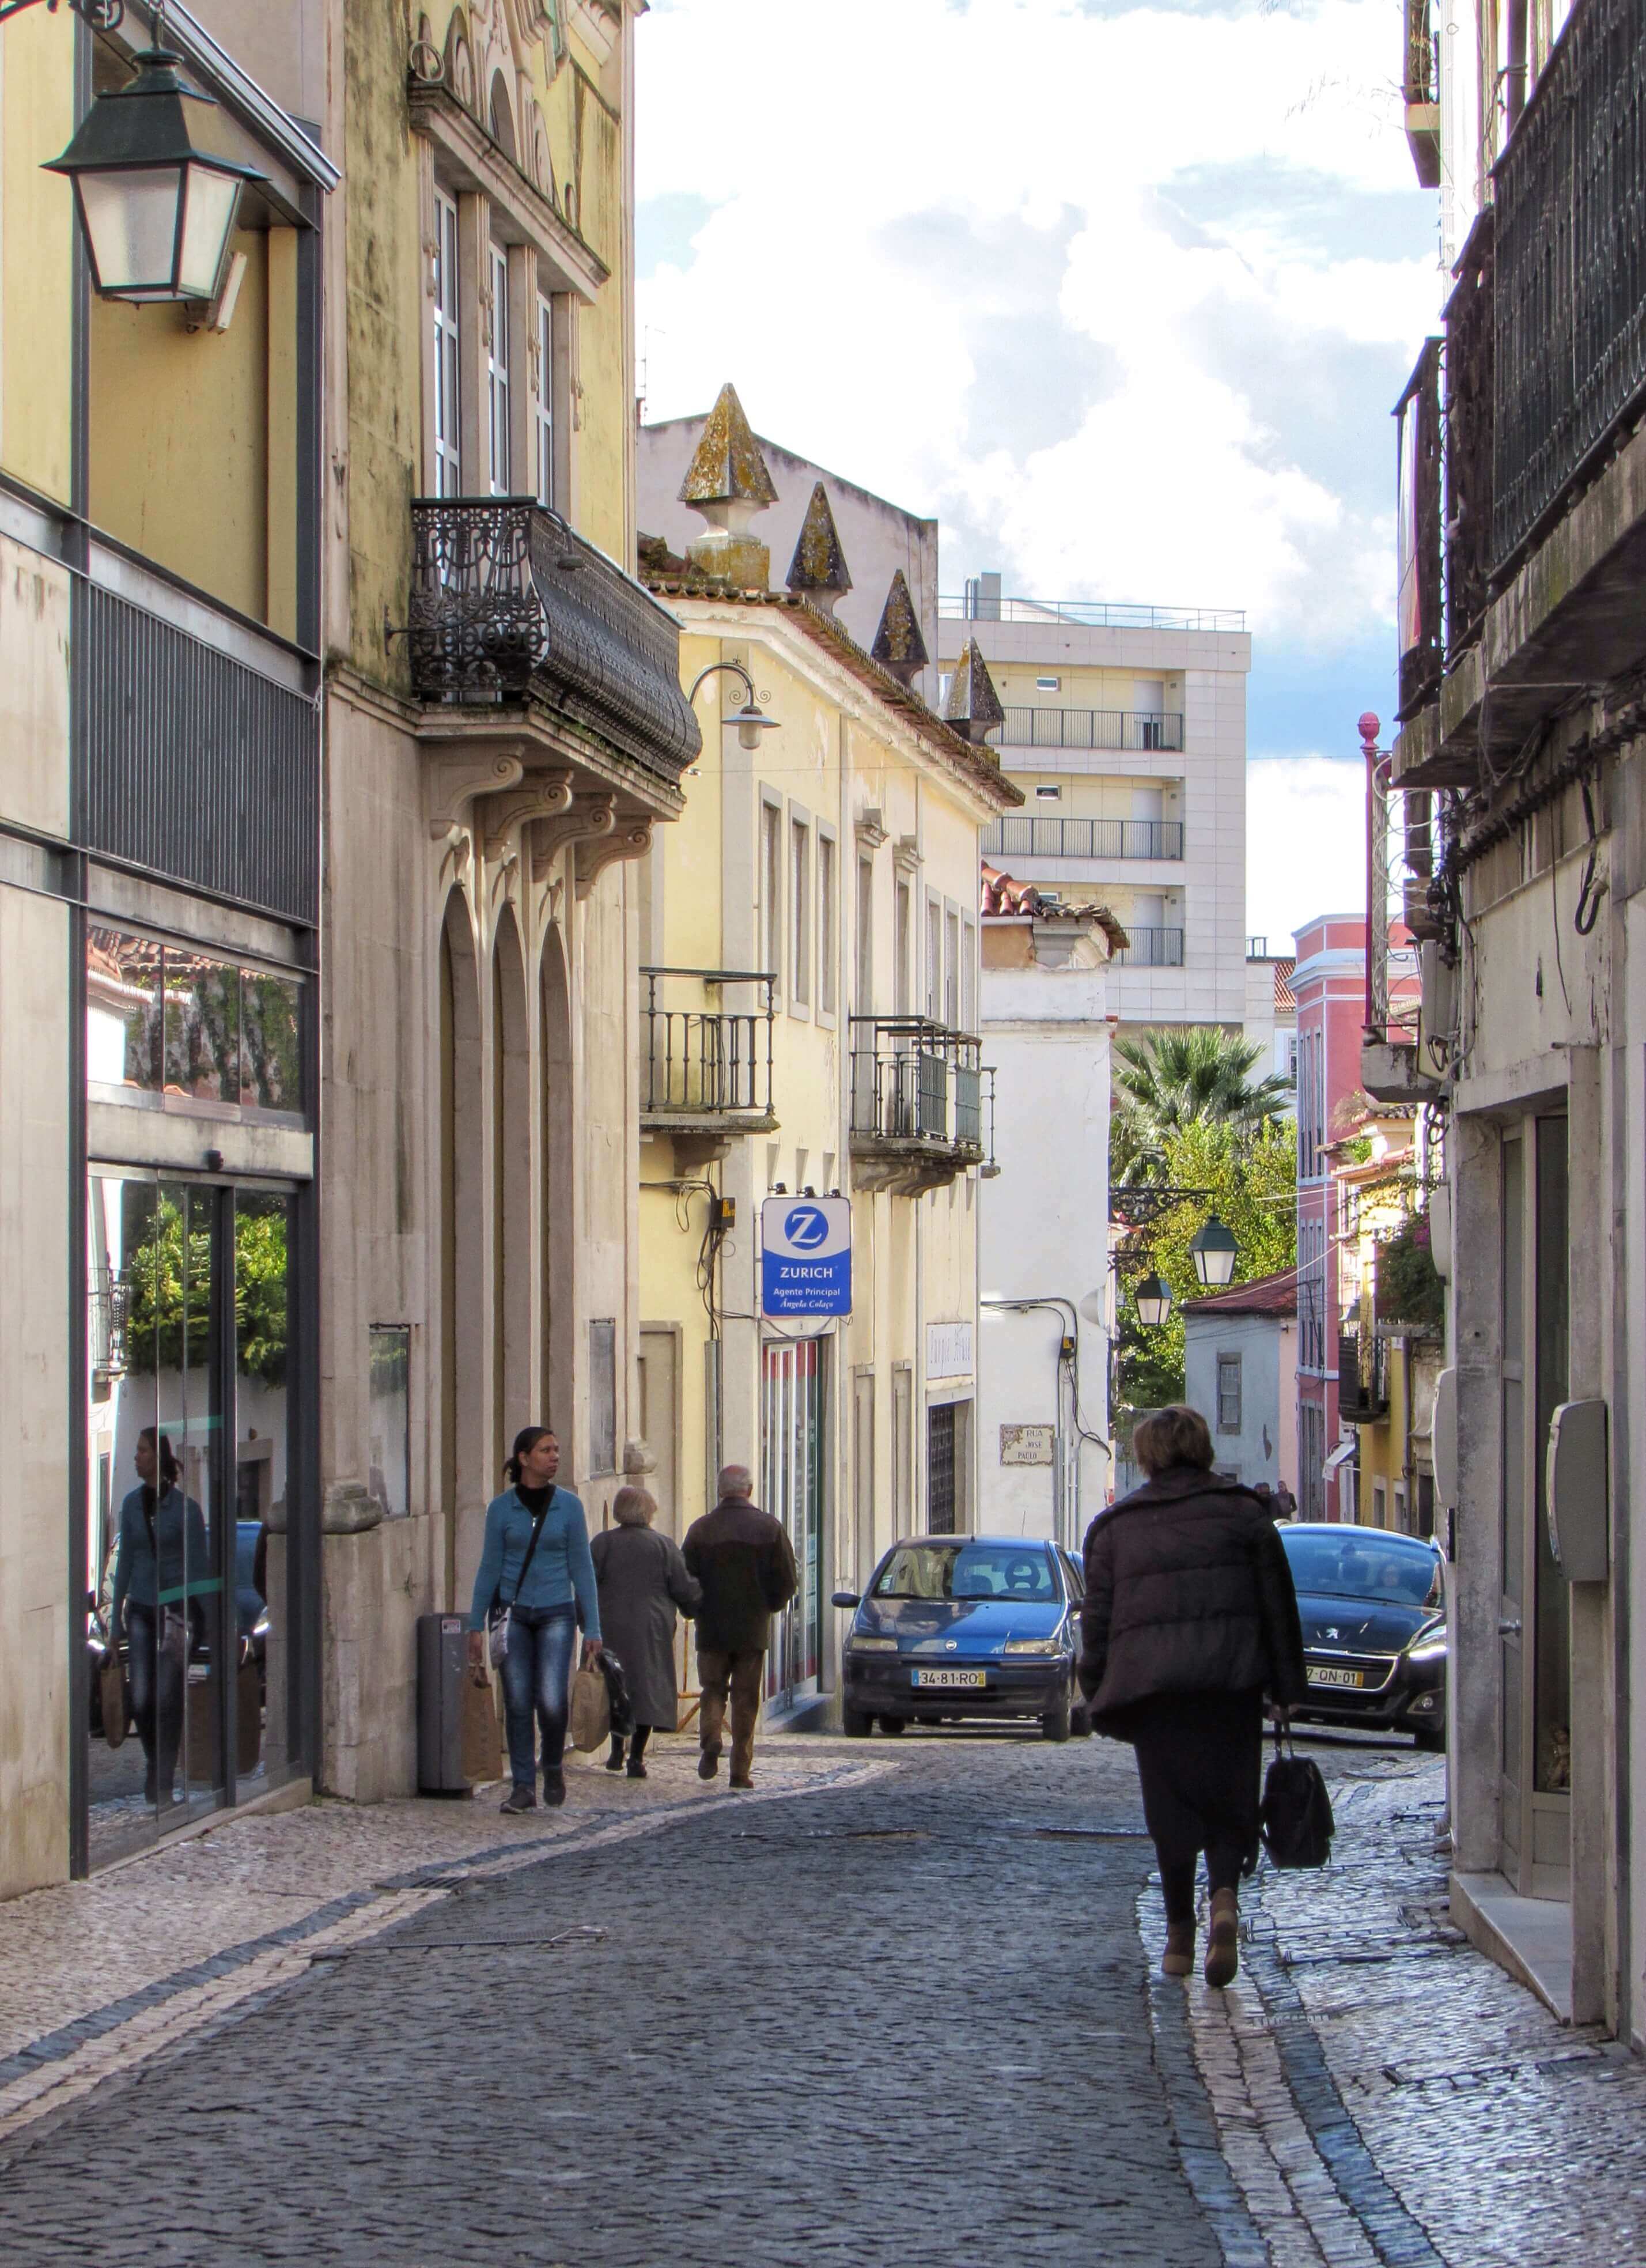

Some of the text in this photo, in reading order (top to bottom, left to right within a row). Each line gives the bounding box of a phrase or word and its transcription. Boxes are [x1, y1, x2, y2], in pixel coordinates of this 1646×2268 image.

[789, 1214, 822, 1243] Z
[780, 1267, 833, 1278] ZURICH
[773, 1287, 840, 1297] Agente Principal
[809, 1300, 834, 1309] Colaço
[1018, 1451, 1037, 1460] PAULO
